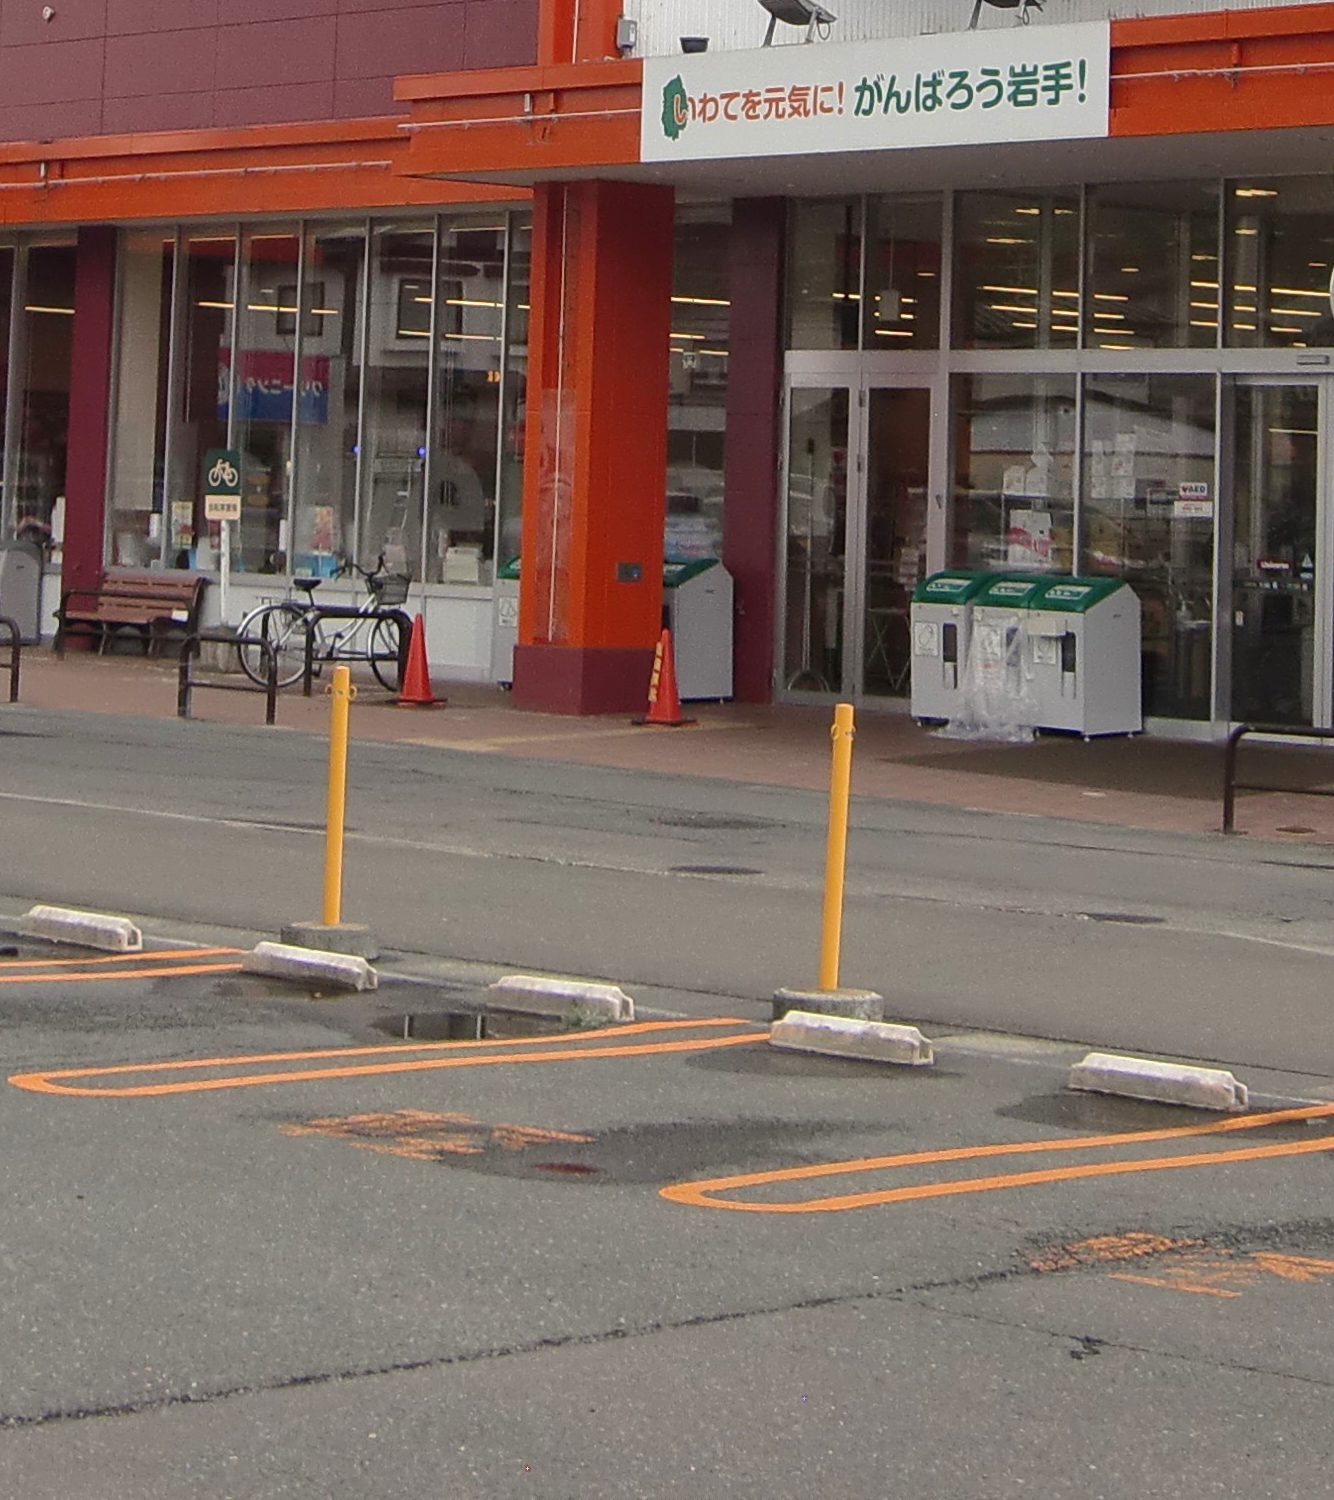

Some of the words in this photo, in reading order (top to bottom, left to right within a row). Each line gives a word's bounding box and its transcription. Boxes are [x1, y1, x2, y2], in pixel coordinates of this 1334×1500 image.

[853, 58, 1088, 117] がんばろう岩手!
